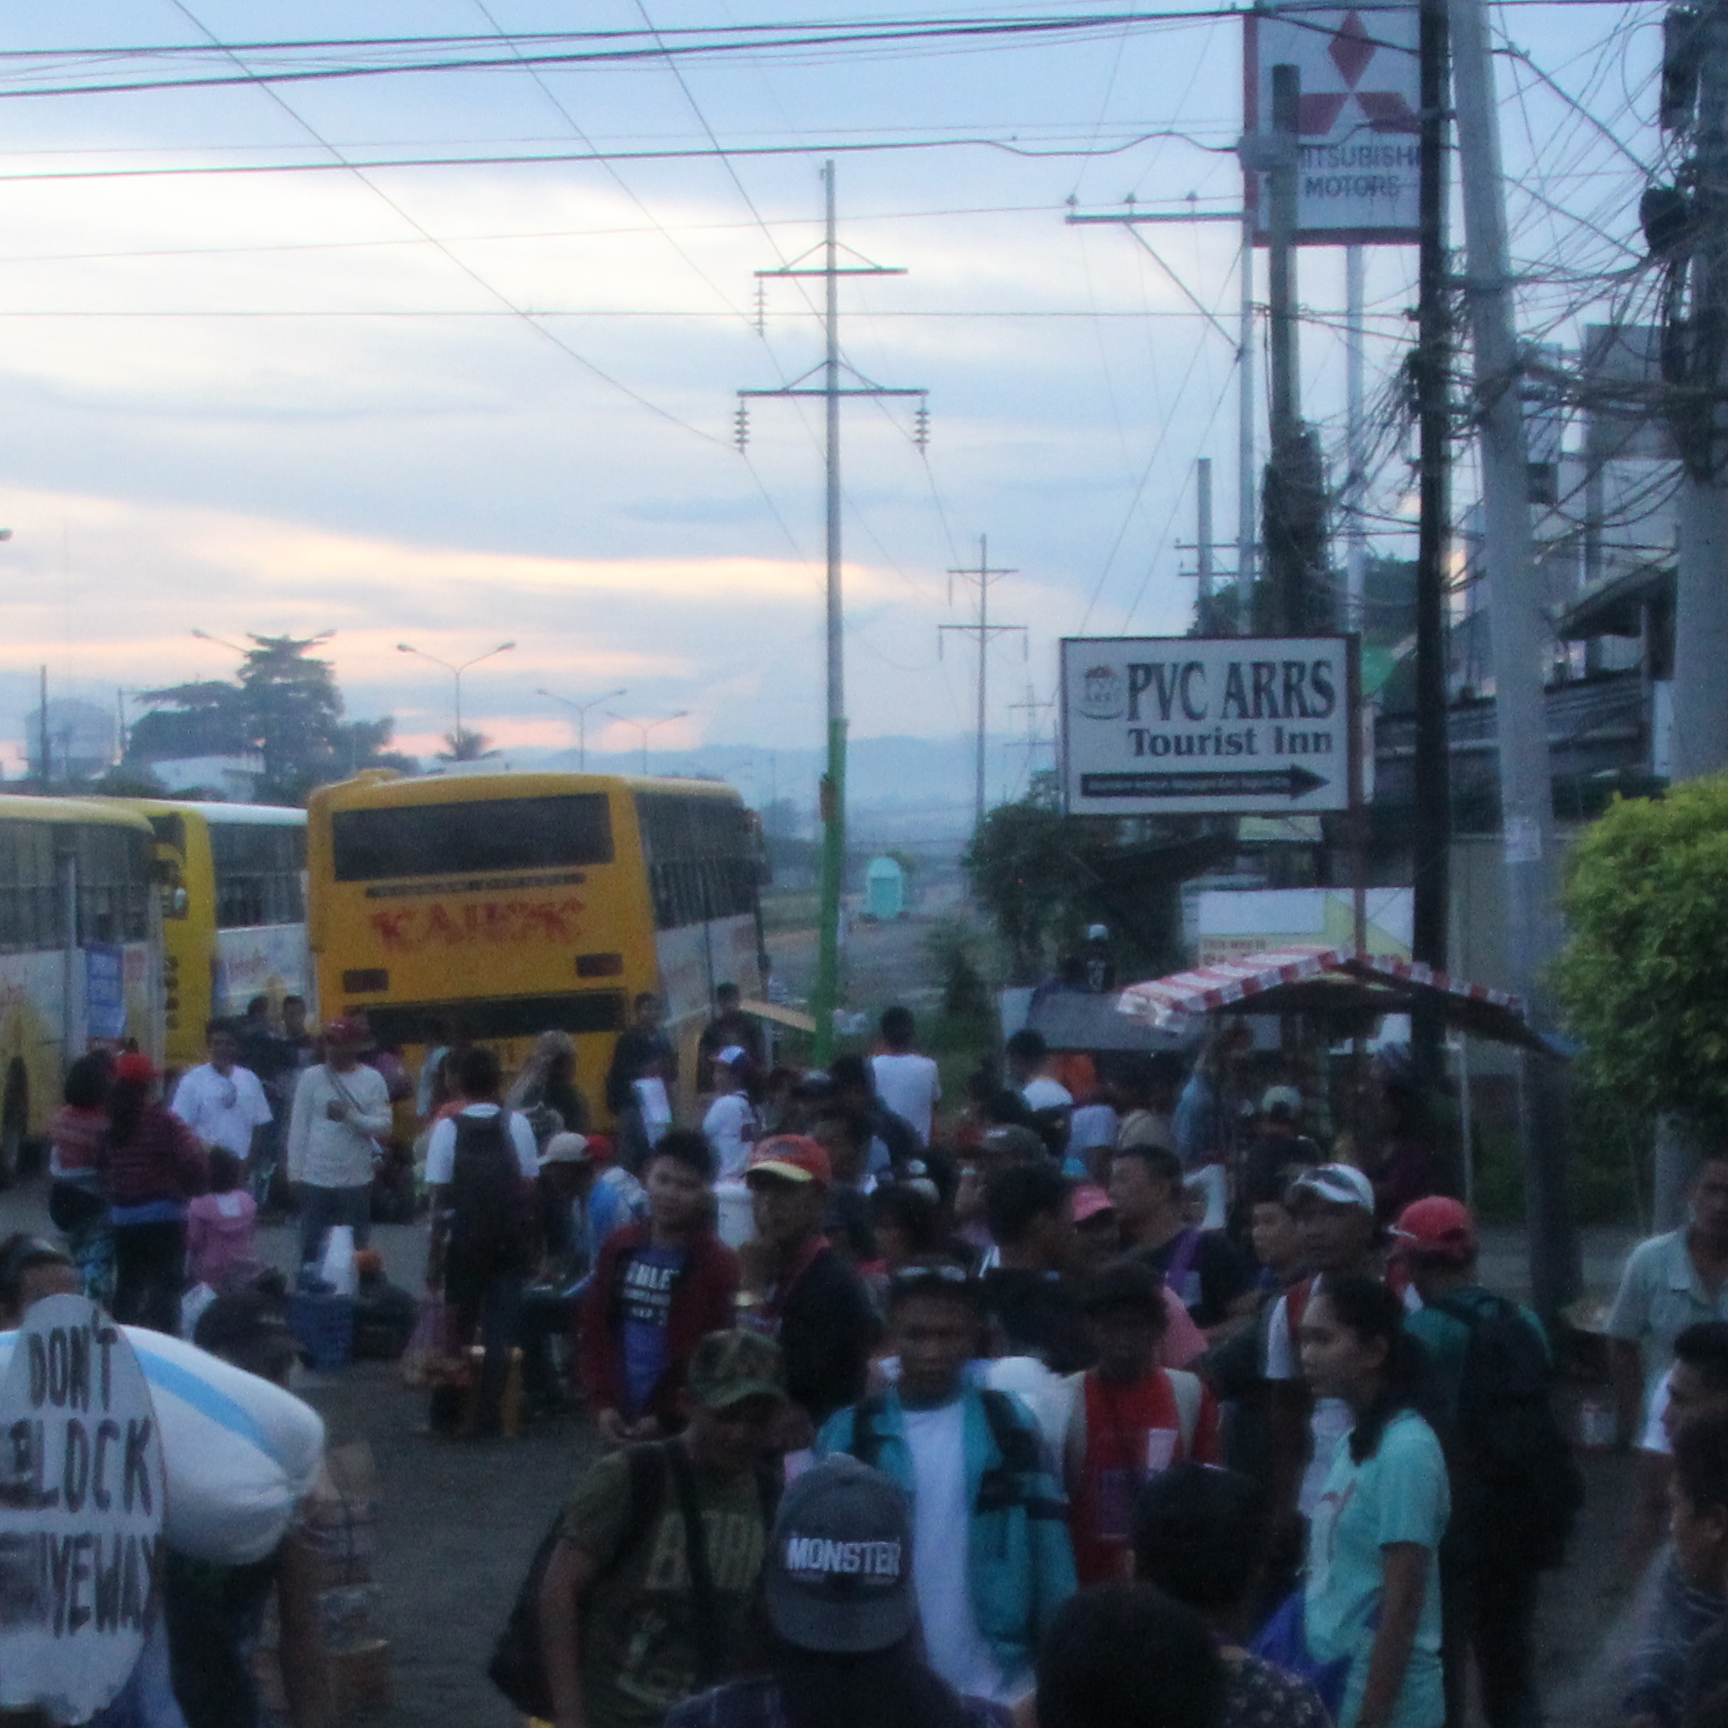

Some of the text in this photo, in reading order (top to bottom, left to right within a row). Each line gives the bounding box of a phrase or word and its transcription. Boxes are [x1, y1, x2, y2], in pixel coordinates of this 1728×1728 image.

[1299, 146, 1421, 170] ITSUBISHI
[1305, 175, 1401, 200] MOTORS
[1127, 659, 1336, 722] PVC ARRS
[1127, 725, 1334, 757] Tourist Inn
[786, 1536, 902, 1577] MONSTER
